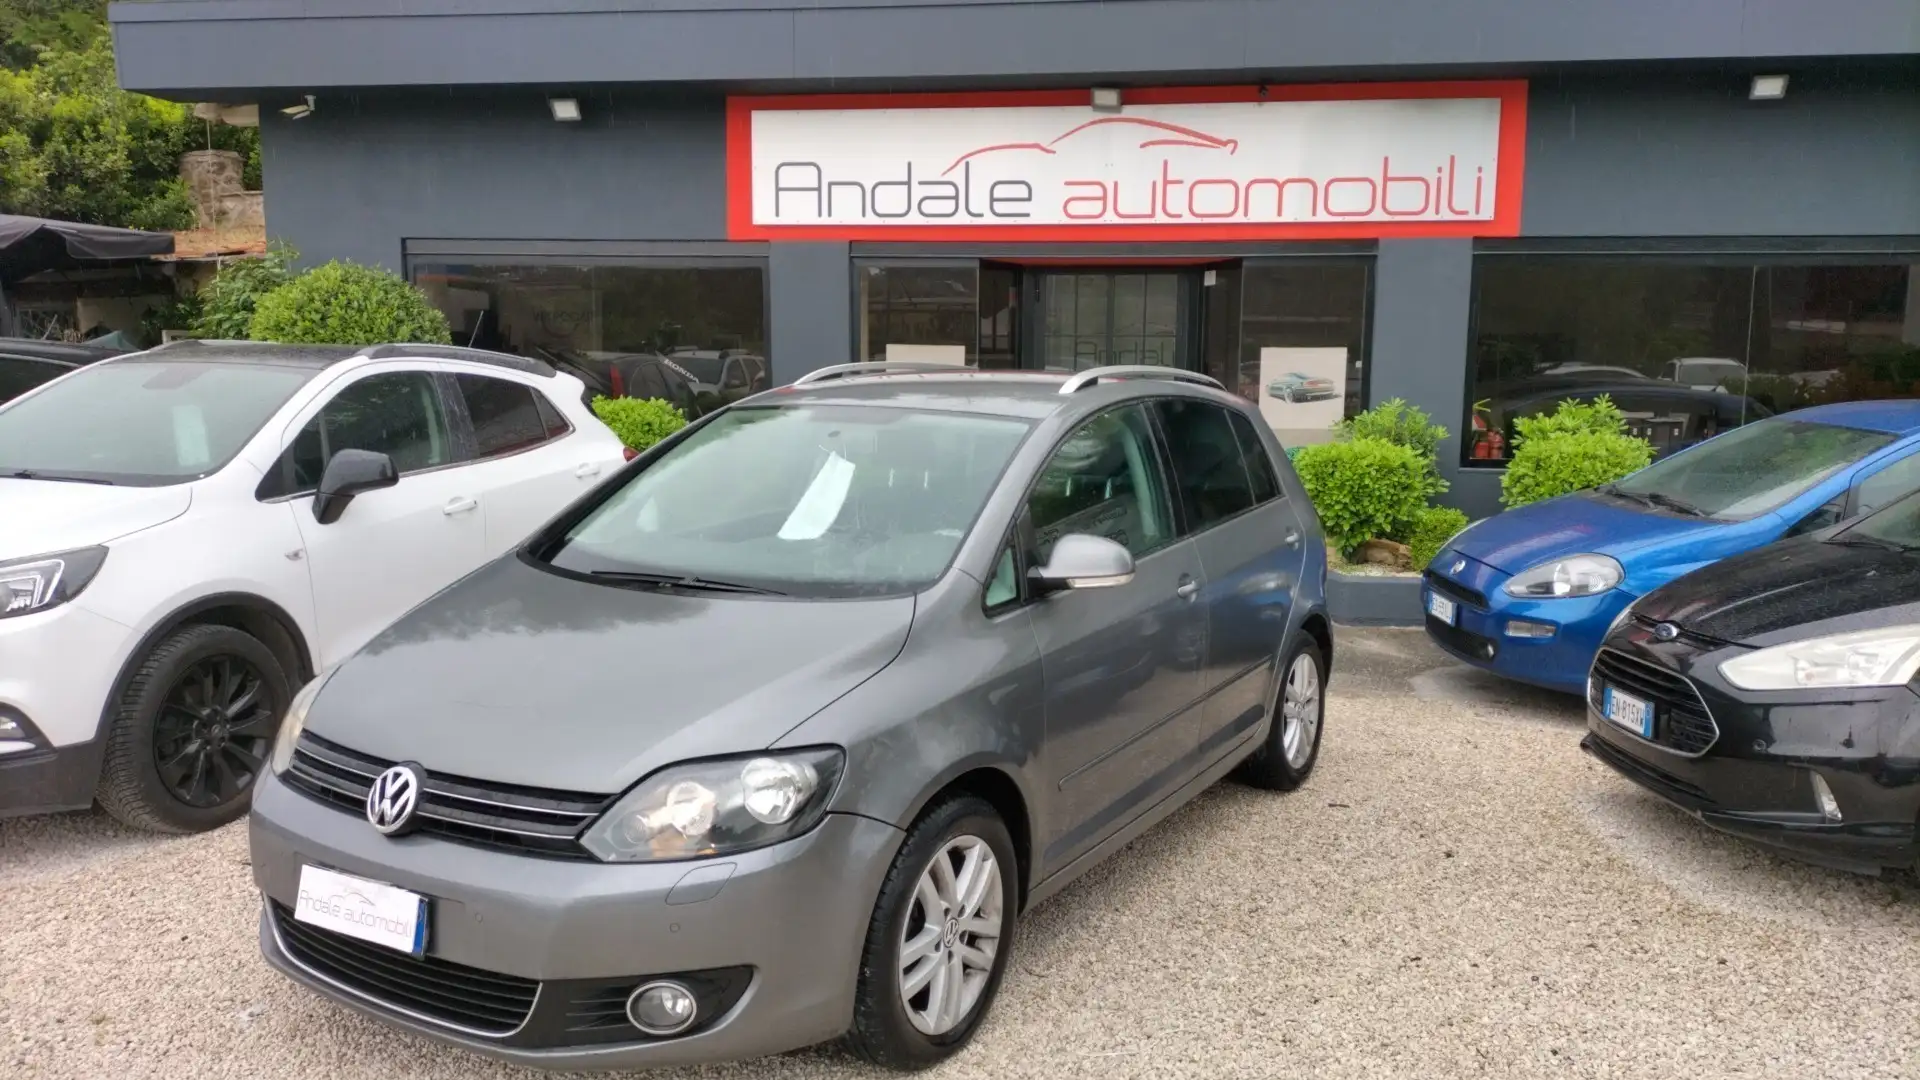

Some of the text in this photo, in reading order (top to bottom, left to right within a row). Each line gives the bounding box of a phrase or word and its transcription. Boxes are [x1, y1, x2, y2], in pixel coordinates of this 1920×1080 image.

[774, 156, 1483, 221] Andale automobili
[298, 889, 413, 938] Andale automobili
